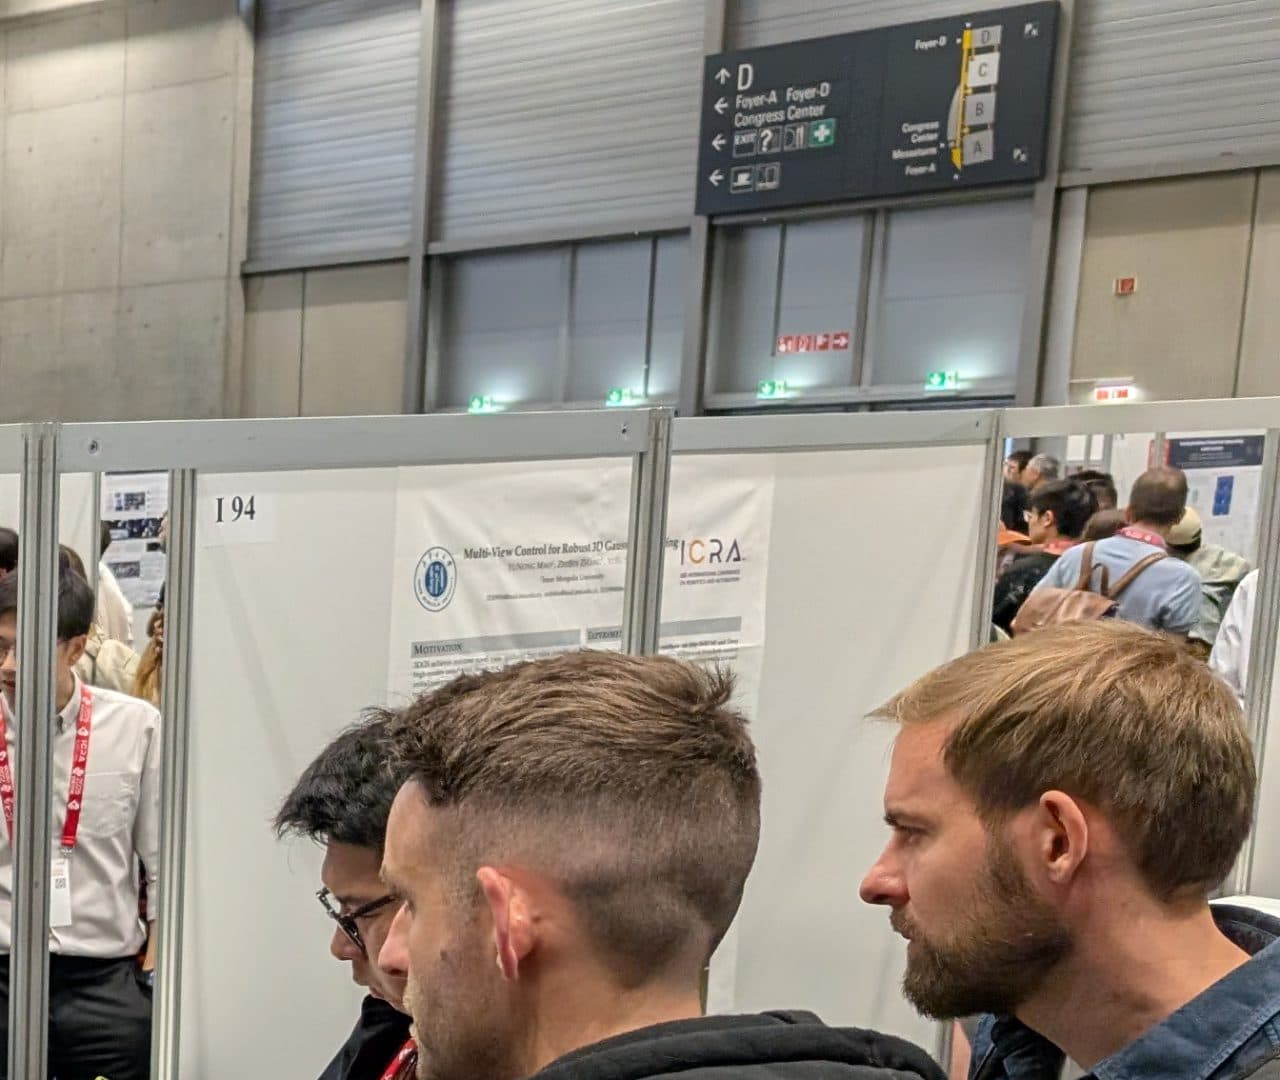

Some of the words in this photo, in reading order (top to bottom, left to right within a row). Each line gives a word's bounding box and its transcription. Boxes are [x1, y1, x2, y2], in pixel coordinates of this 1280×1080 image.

[981, 30, 990, 43] D
[737, 63, 753, 91] D
[979, 63, 988, 77] C
[736, 90, 777, 109] Foyer-A
[786, 82, 830, 102] Foyer-D
[734, 110, 785, 127] Congress
[787, 105, 826, 120] Center
[975, 103, 984, 116] B
[974, 141, 983, 154] A
[216, 497, 224, 522] I
[232, 495, 256, 522] 94
[464, 546, 512, 560] Multi-View
[514, 543, 547, 557] Control
[547, 542, 560, 555] for
[561, 541, 591, 555] Robust
[592, 540, 604, 553] 3D
[680, 538, 742, 566] ICRA
